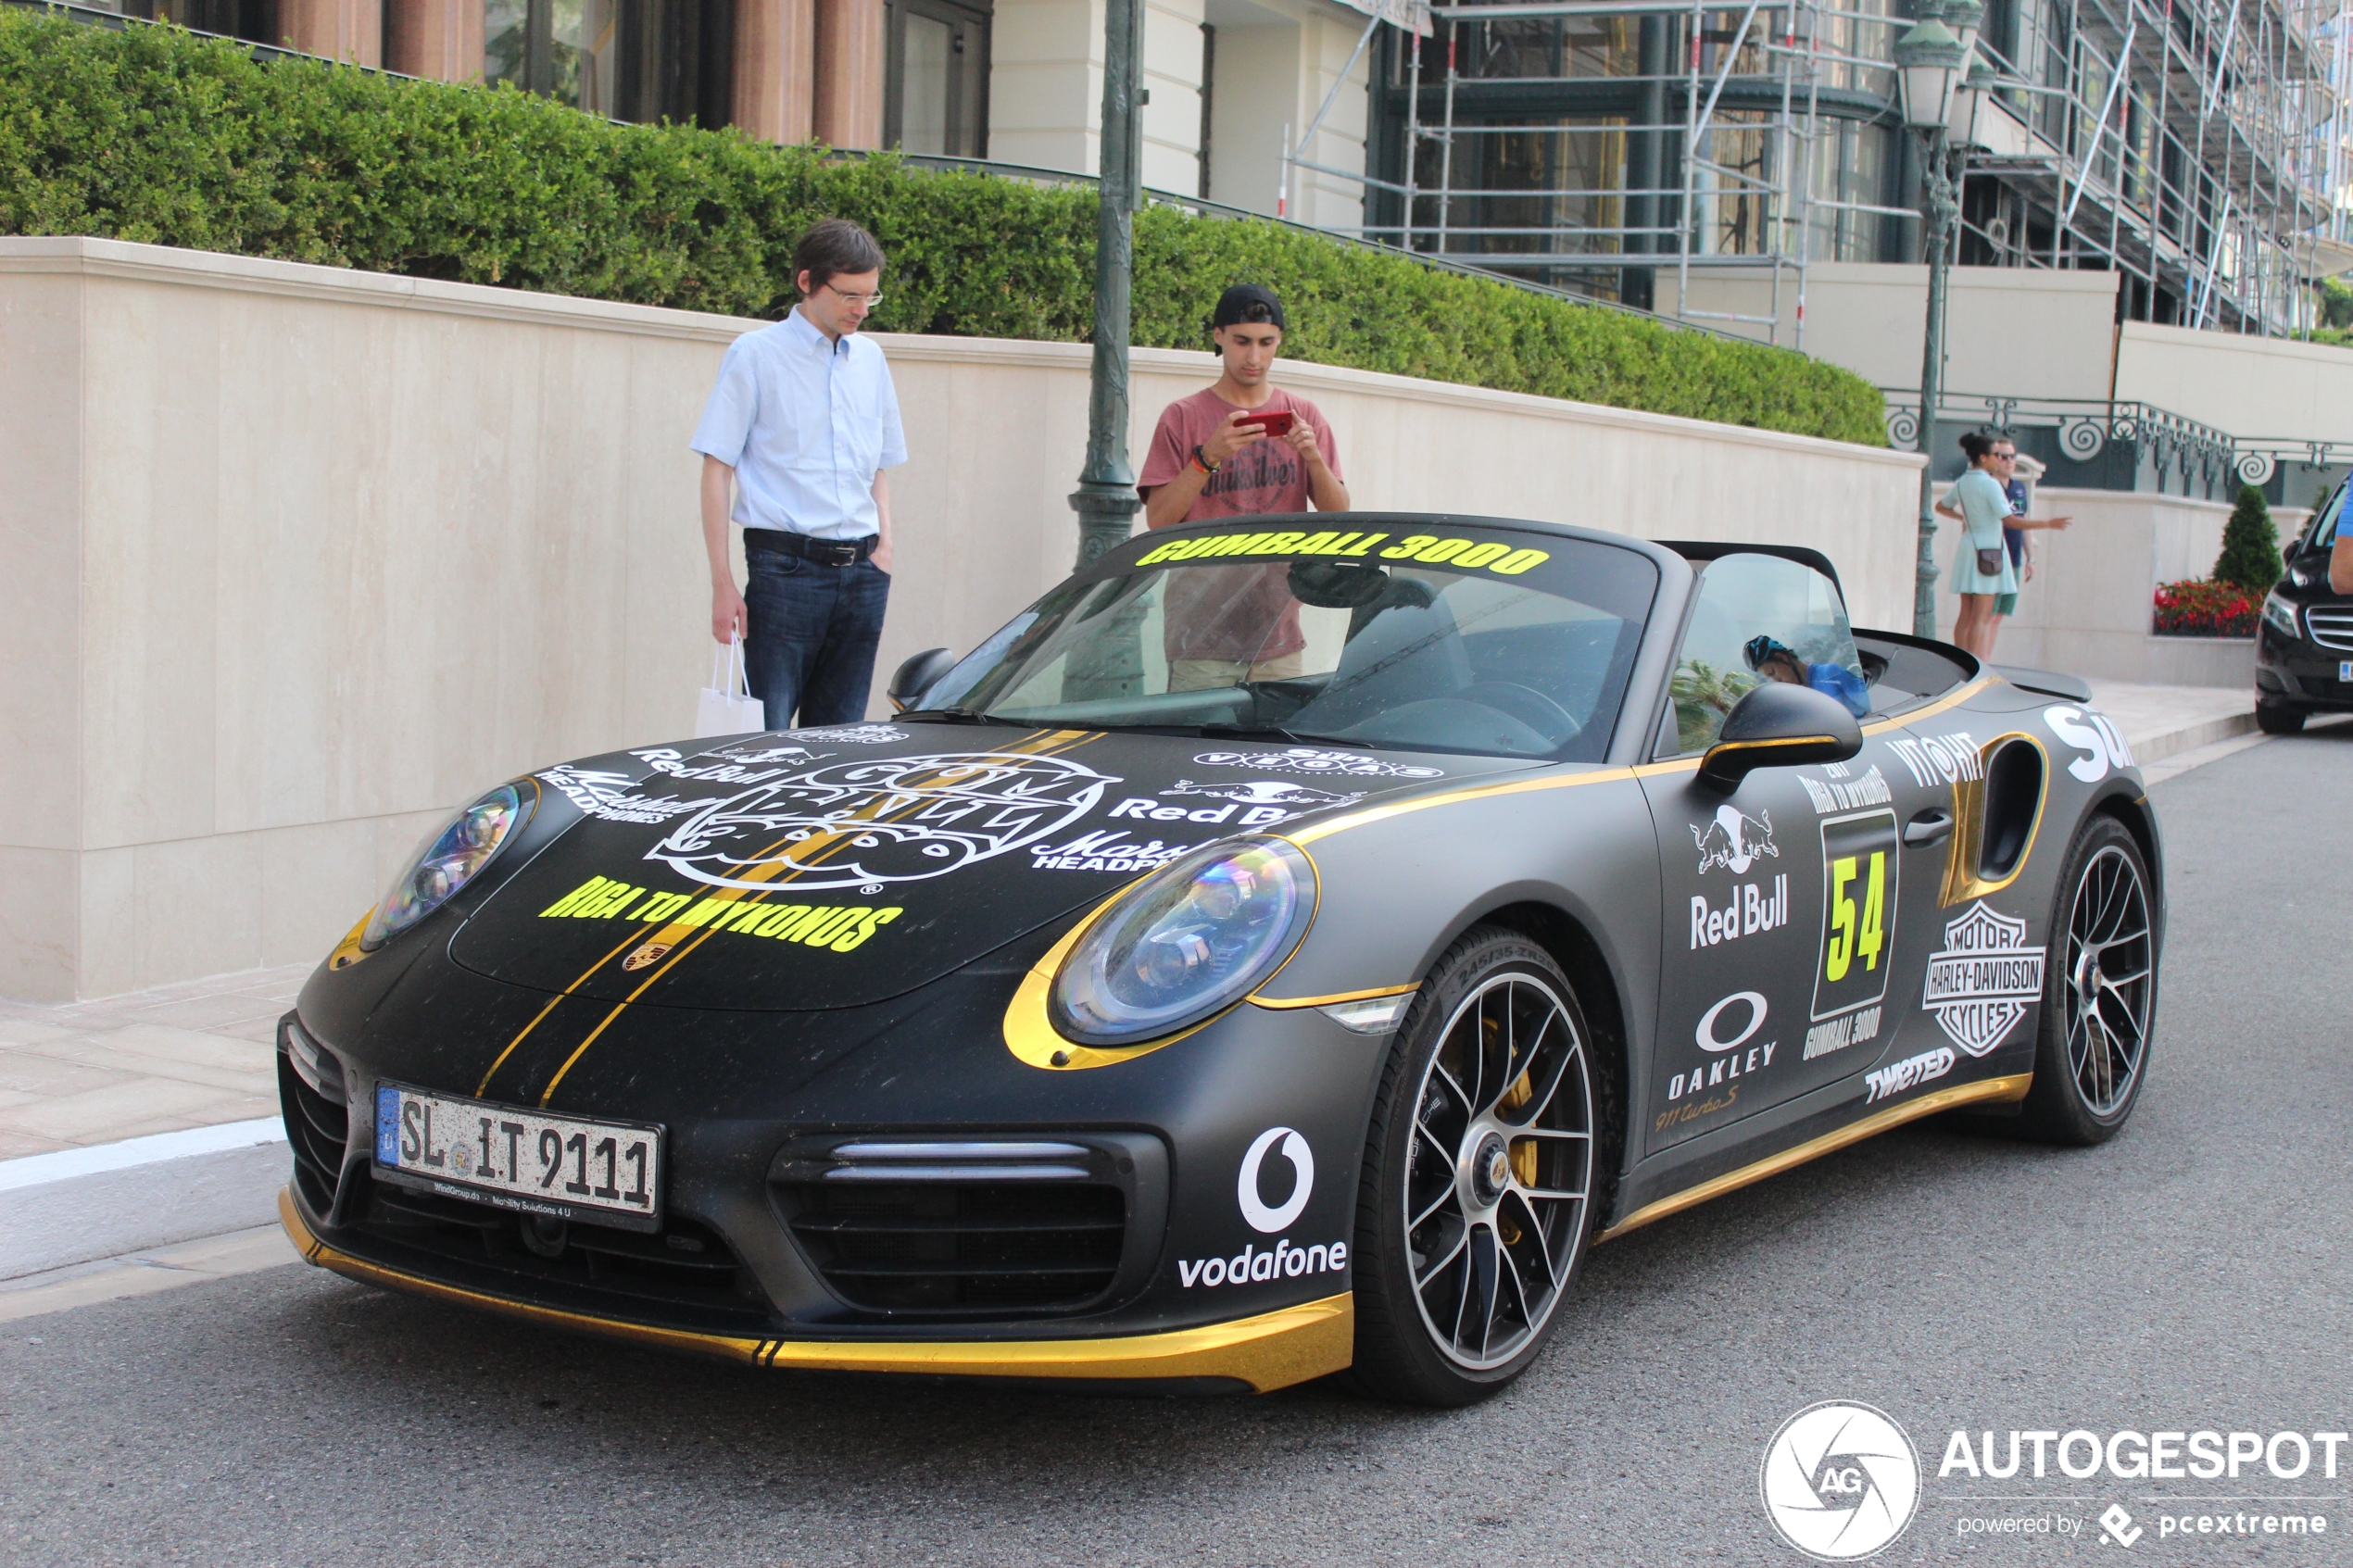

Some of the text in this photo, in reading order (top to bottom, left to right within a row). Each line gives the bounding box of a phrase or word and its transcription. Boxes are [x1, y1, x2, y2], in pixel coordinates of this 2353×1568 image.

[1136, 532, 1550, 575] GUMBALL 3000
[628, 748, 790, 785] Red Bull
[1206, 753, 1438, 777] VEGAS
[1796, 764, 1892, 814] RIGA TO MYKONOS
[534, 770, 673, 824] HEADPHONES
[1108, 797, 1239, 823] Red
[1030, 830, 1219, 859] Mars
[539, 874, 904, 953] RIGA TO MYKONOS
[1691, 873, 1787, 949] Red Bull
[1826, 851, 1885, 983] 54
[1953, 916, 2011, 951] MOTOR
[1930, 960, 2039, 996] HARLEY-DAVIDSON
[1803, 1006, 1881, 1061] GUMBALL 3000
[1949, 1002, 2008, 1045] CYCLES
[1668, 1041, 1777, 1100] OAKLEY
[1865, 1047, 1956, 1105] TWISTED
[1655, 1085, 1740, 1132] 911 turbo S
[383, 1133, 394, 1151] D
[401, 1100, 650, 1204] SL IT 9111
[1409, 1097, 1442, 1170] POCHE
[434, 1183, 480, 1201] WindGroup.de
[492, 1196, 521, 1210] Mobility
[522, 1201, 556, 1215] Solutions
[1177, 1238, 1347, 1288] vodafone
